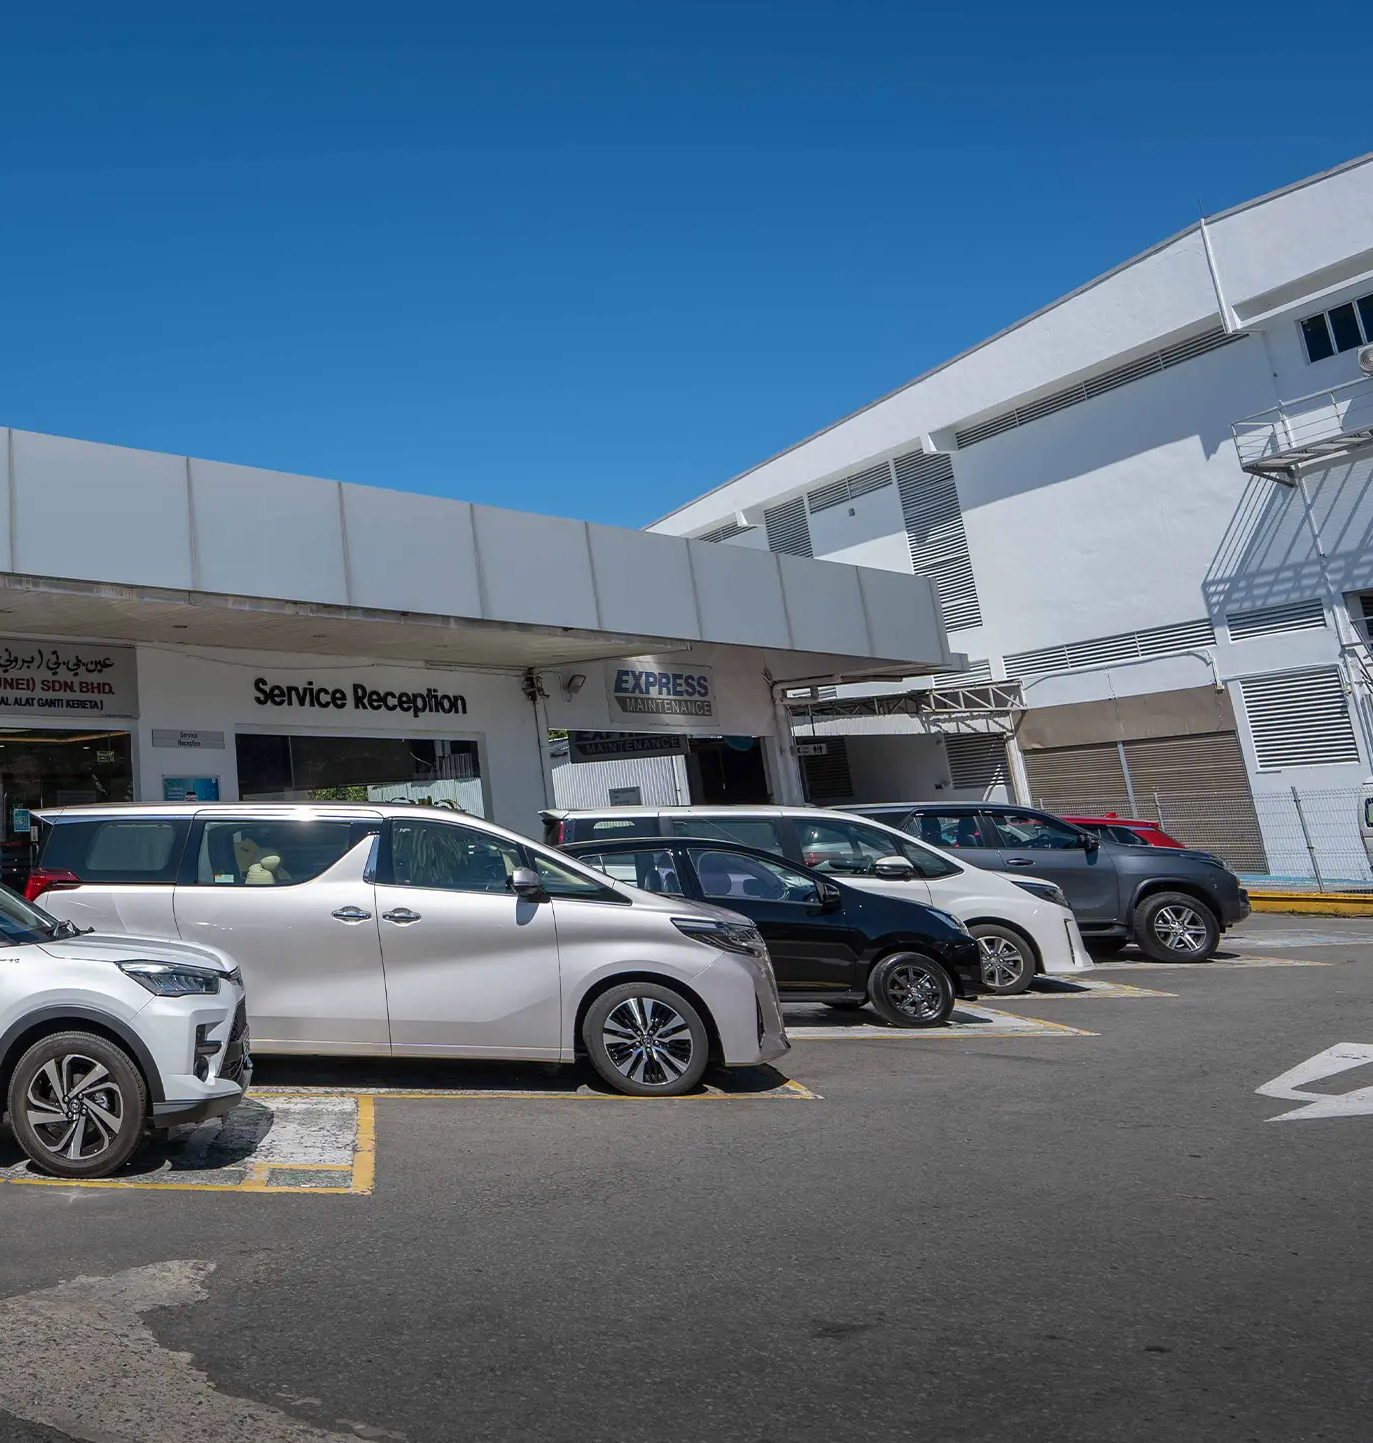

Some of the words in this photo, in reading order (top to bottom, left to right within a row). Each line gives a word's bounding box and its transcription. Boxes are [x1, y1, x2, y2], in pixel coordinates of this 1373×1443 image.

[40, 679, 77, 693] SDN.
[79, 681, 115, 695] BHD.
[613, 669, 708, 698] EXPRESS
[13, 697, 35, 707] ALAT
[37, 698, 64, 708] GANTI
[254, 677, 347, 709] Service
[352, 683, 467, 718] Reception
[626, 698, 712, 715] MAINTENANCE
[177, 739, 201, 747] Reception
[179, 731, 198, 739] Service
[586, 736, 680, 754] MAINTENANCE
